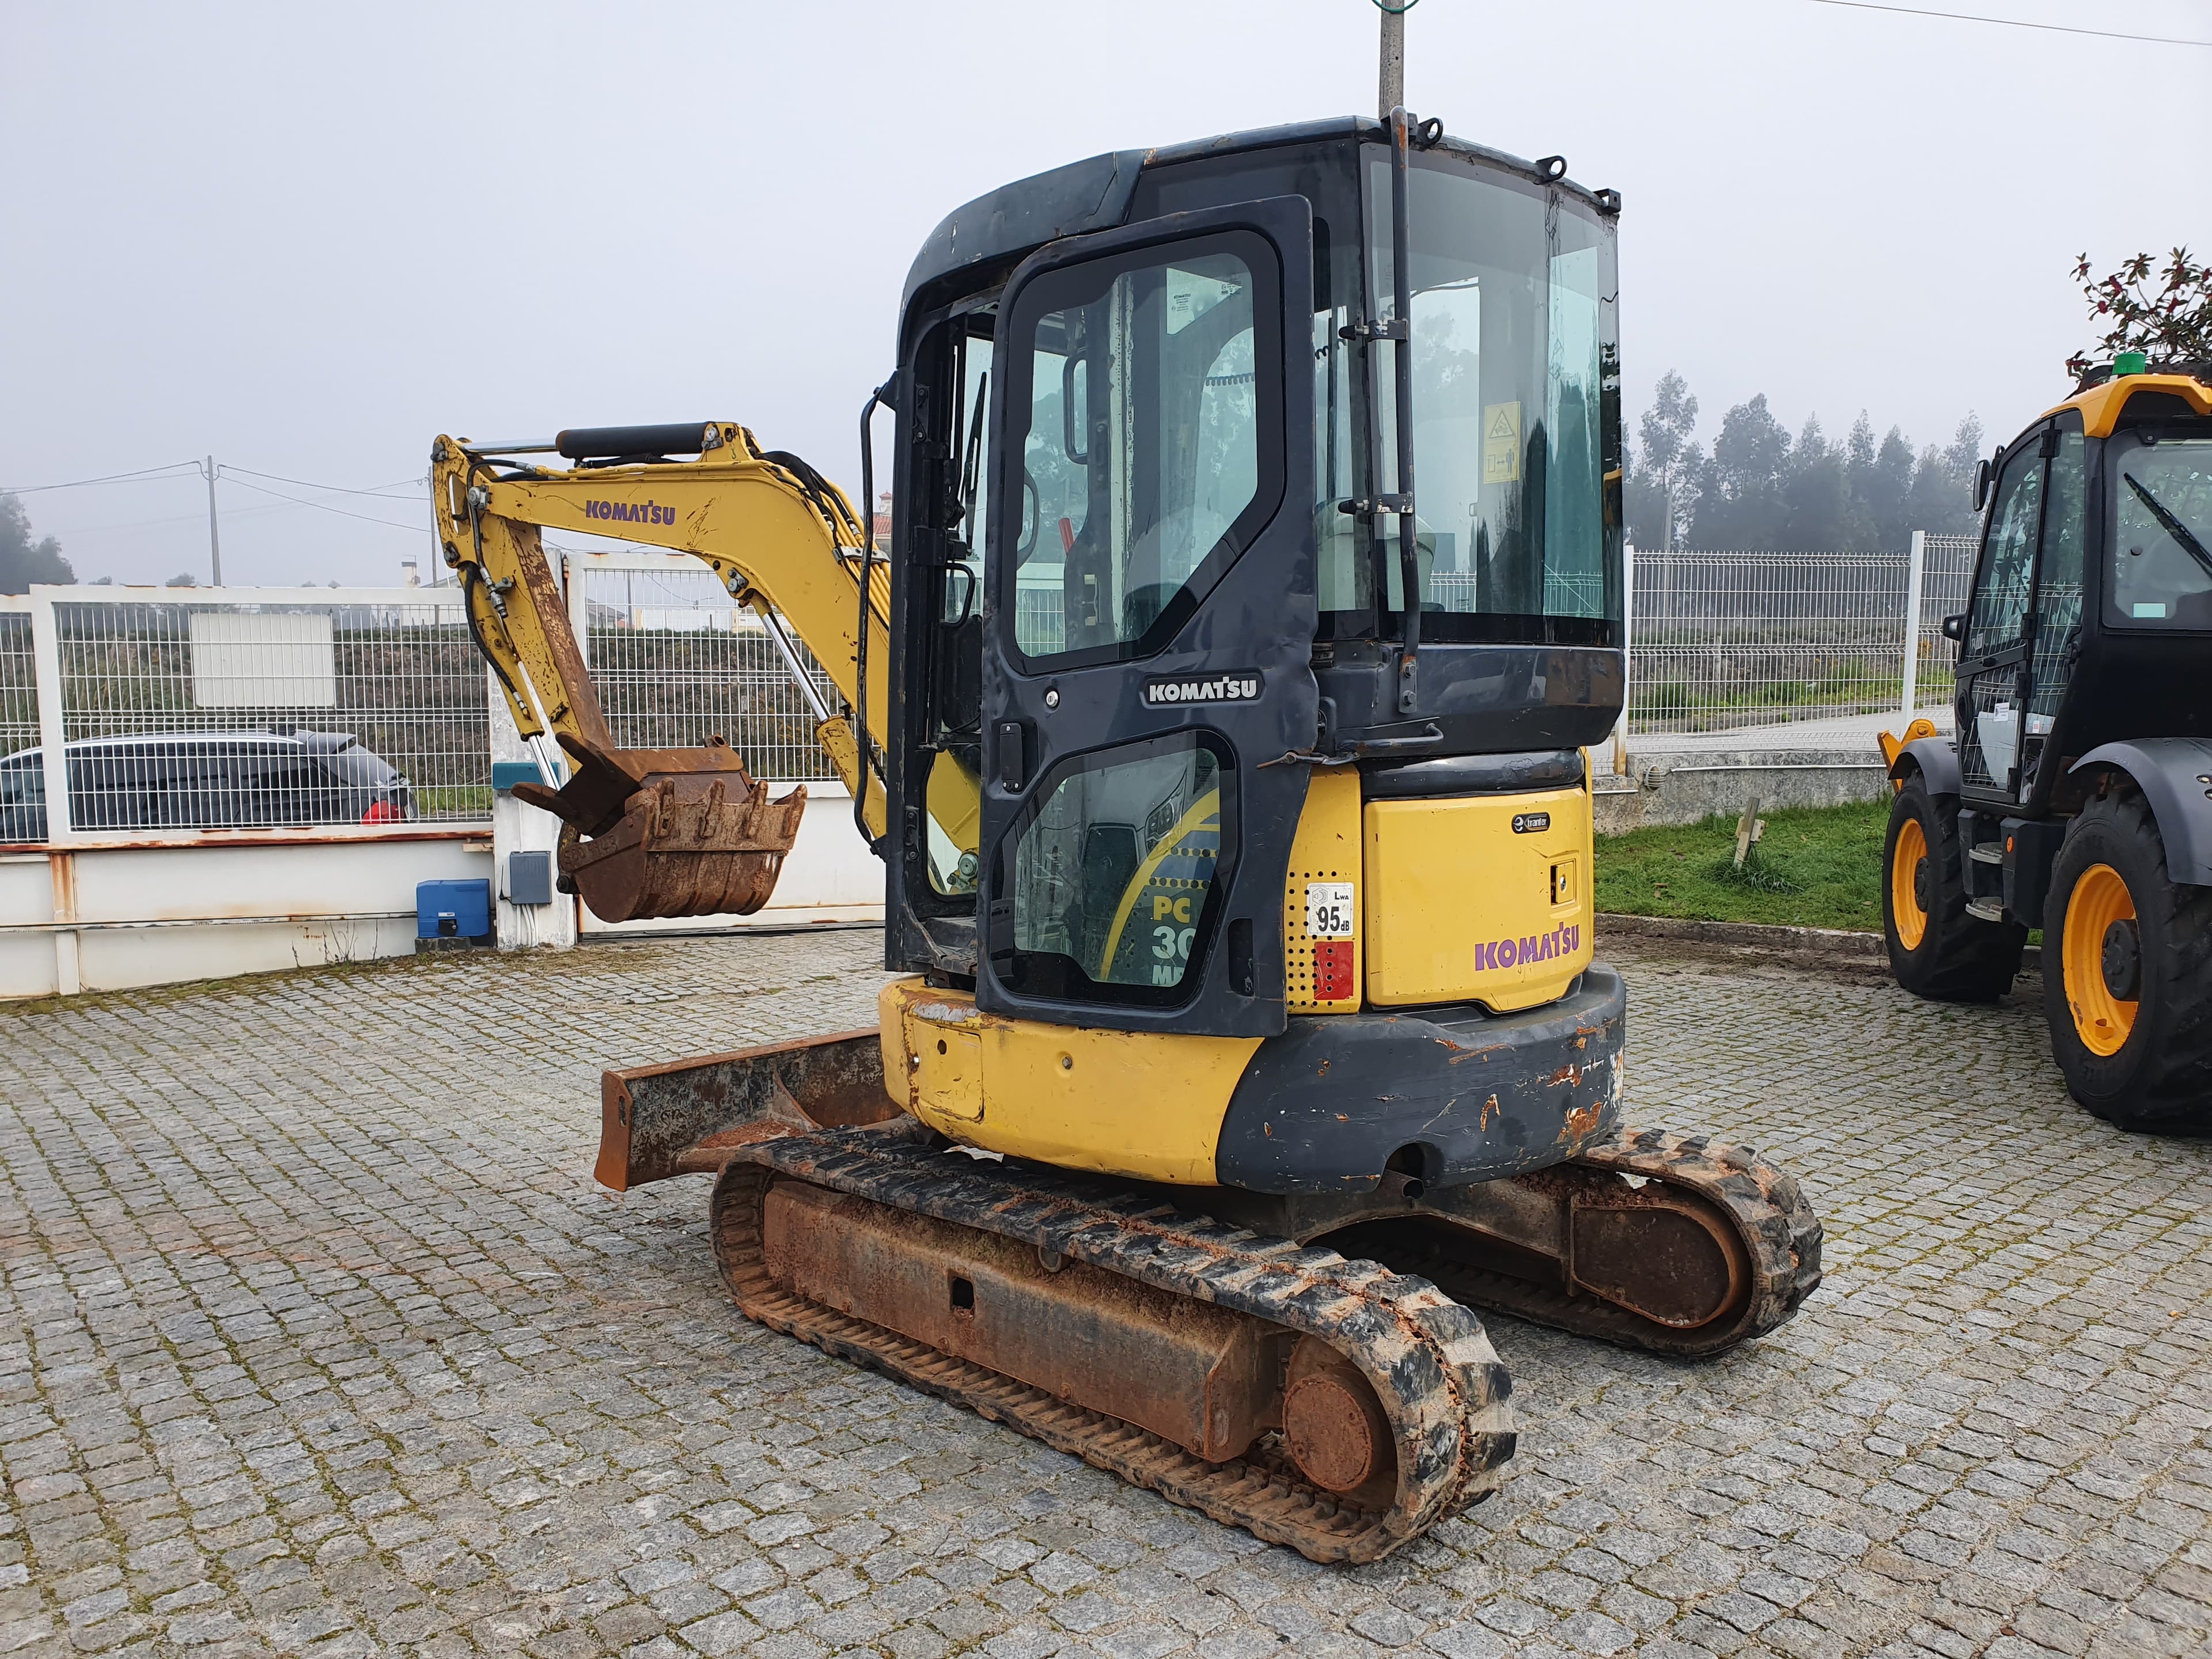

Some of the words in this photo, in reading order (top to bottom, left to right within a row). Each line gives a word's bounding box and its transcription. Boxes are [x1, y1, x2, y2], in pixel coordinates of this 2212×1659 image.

[585, 499, 676, 525] KOMATSU
[1149, 676, 1257, 702] KOMATSU
[1153, 895, 1191, 923] PC
[1152, 926, 1197, 960] 30
[1475, 921, 1580, 971] KOMATSU
